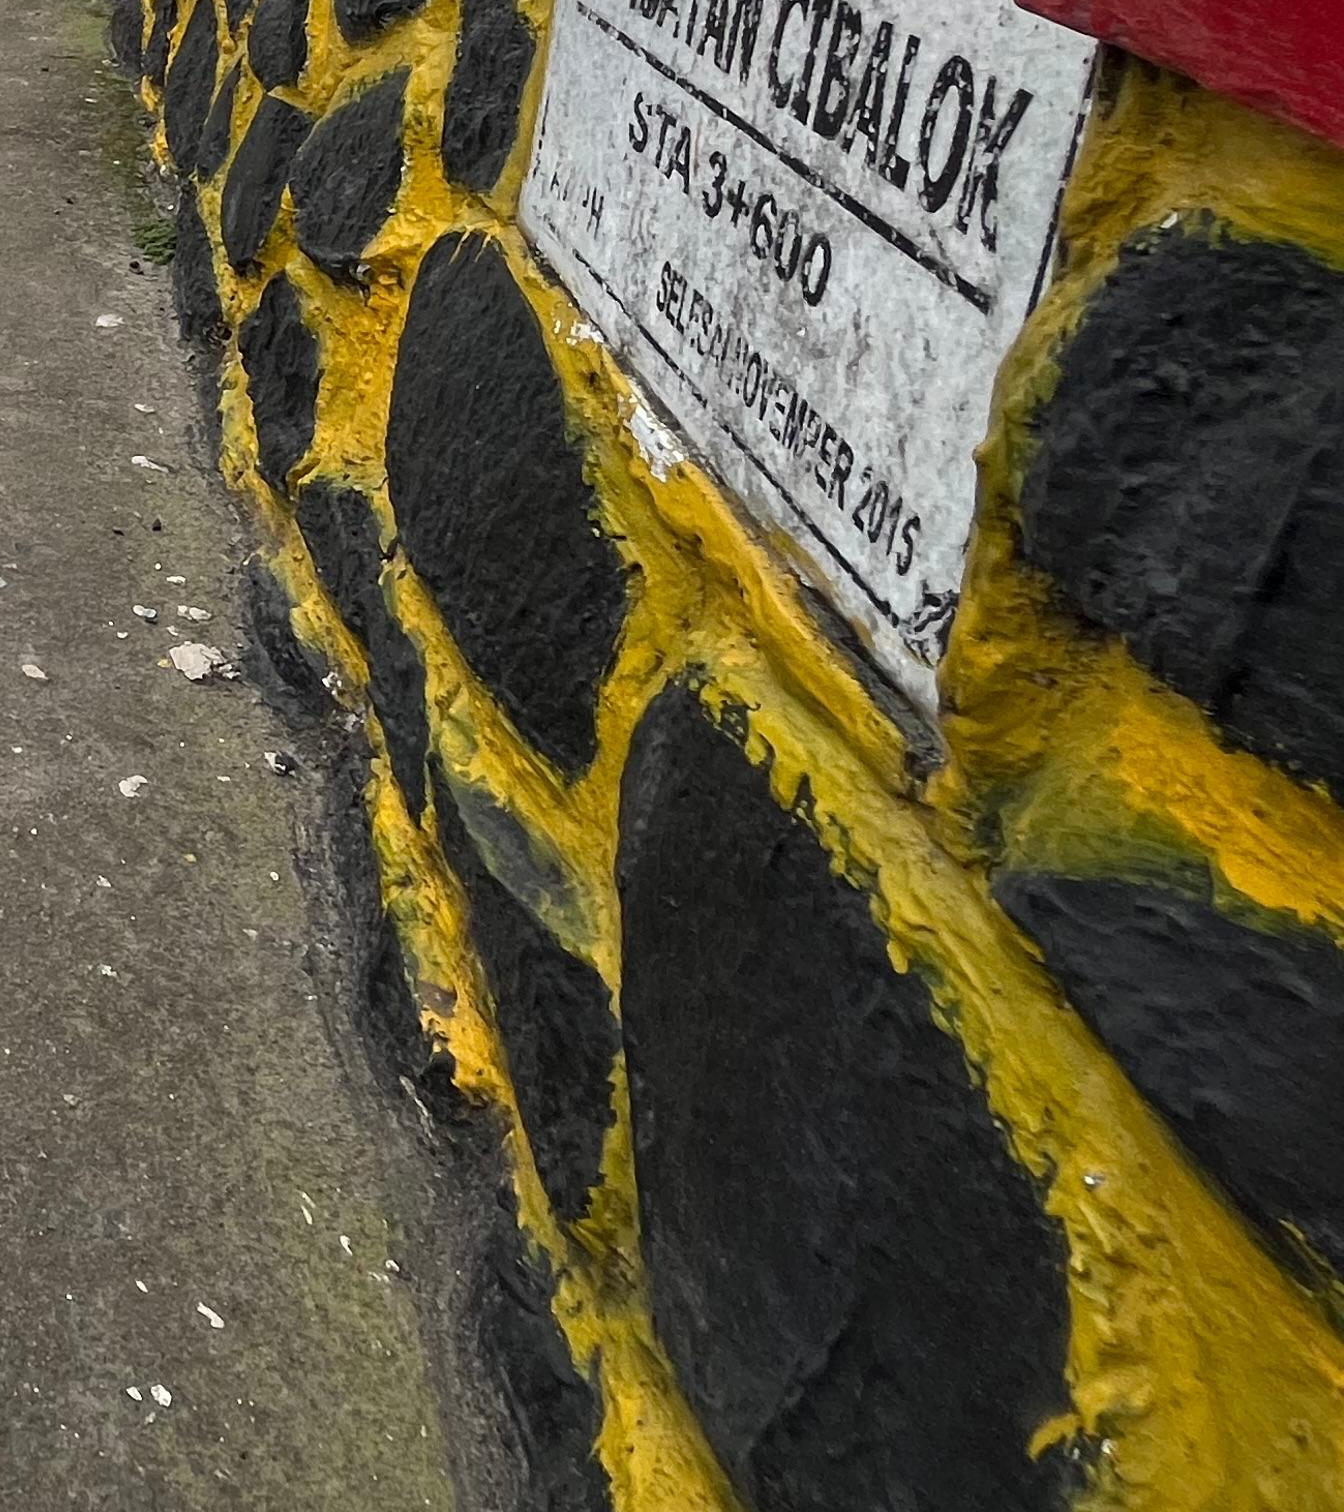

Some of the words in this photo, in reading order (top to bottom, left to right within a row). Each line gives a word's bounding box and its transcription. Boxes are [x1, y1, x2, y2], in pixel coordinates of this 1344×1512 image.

[628, 90, 693, 196] STA
[702, 151, 833, 307] 3+600
[851, 469, 922, 577] 2015
